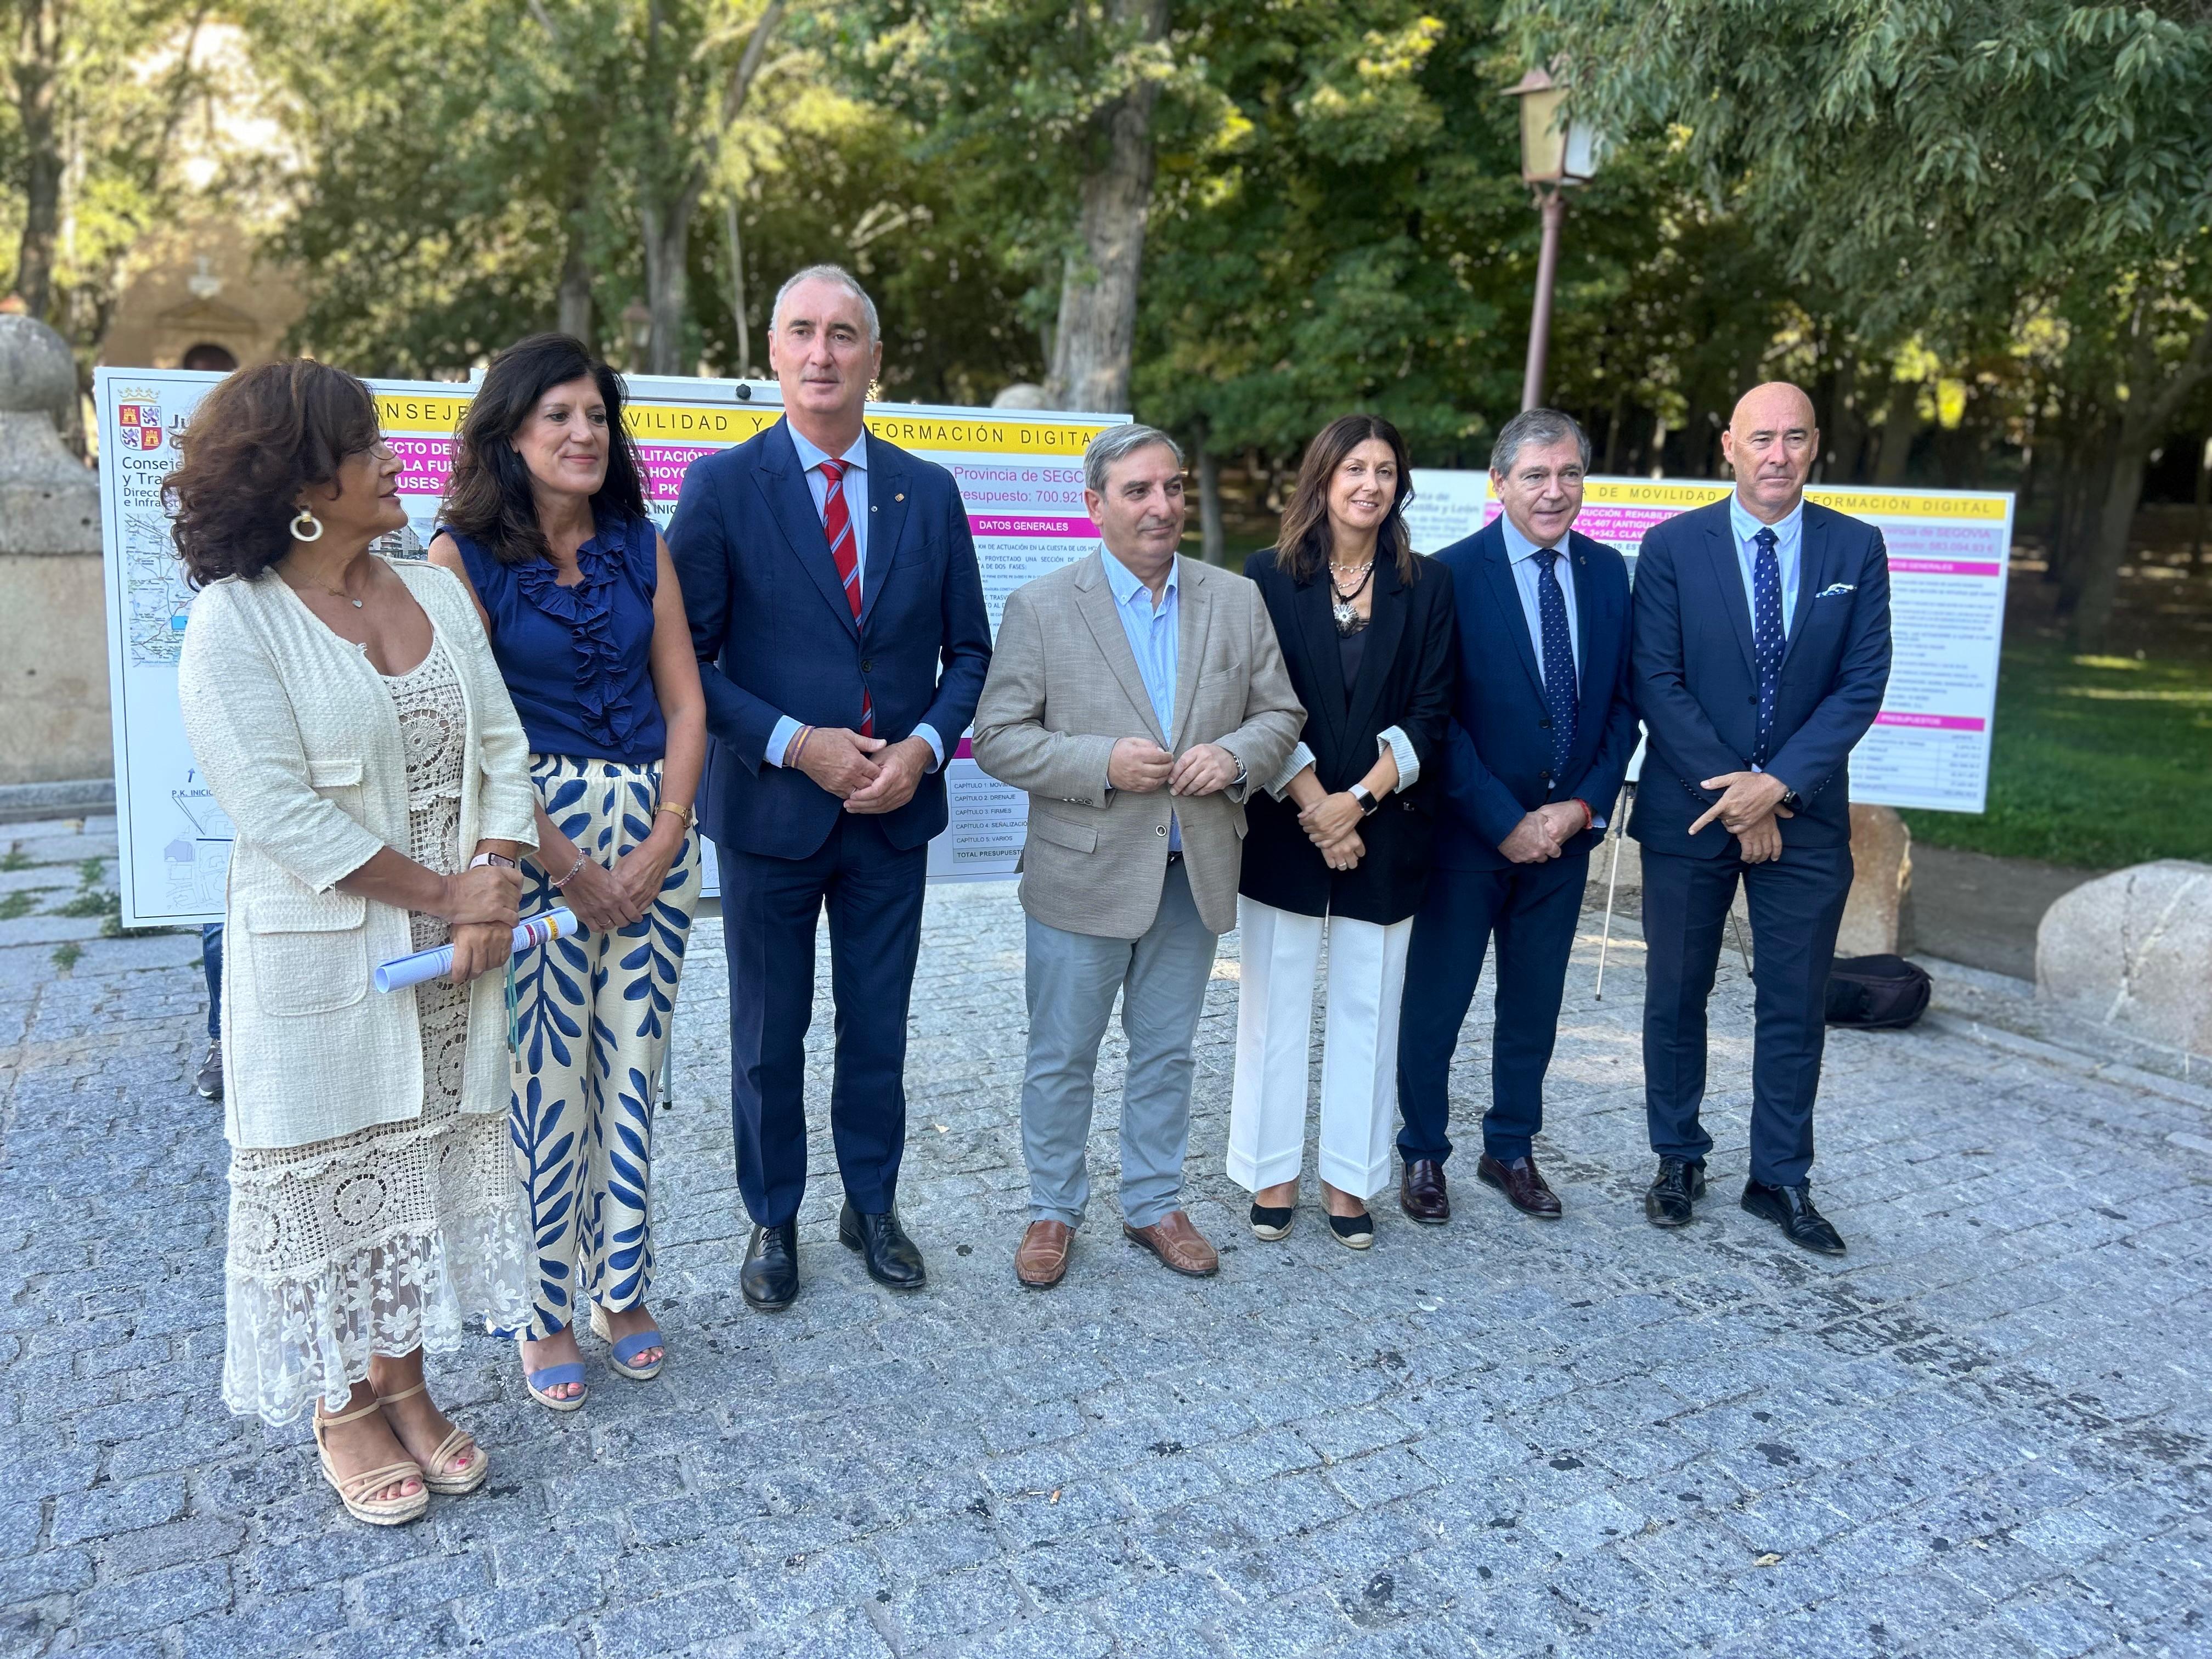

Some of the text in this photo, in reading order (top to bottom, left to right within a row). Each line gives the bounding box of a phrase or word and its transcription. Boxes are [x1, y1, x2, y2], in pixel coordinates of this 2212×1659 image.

[629, 413, 727, 430] VILIDAD
[752, 417, 763, 432] Y
[1022, 430, 1099, 446] DIGITA
[122, 475, 131, 487] y
[955, 467, 1017, 482] Provincia
[1022, 470, 1038, 482] de
[1599, 487, 1618, 497] DE
[1629, 488, 1716, 501] MOVILIDAD
[1922, 500, 1990, 514] DIGITAL
[979, 521, 1069, 532] DATOS GENERALES
